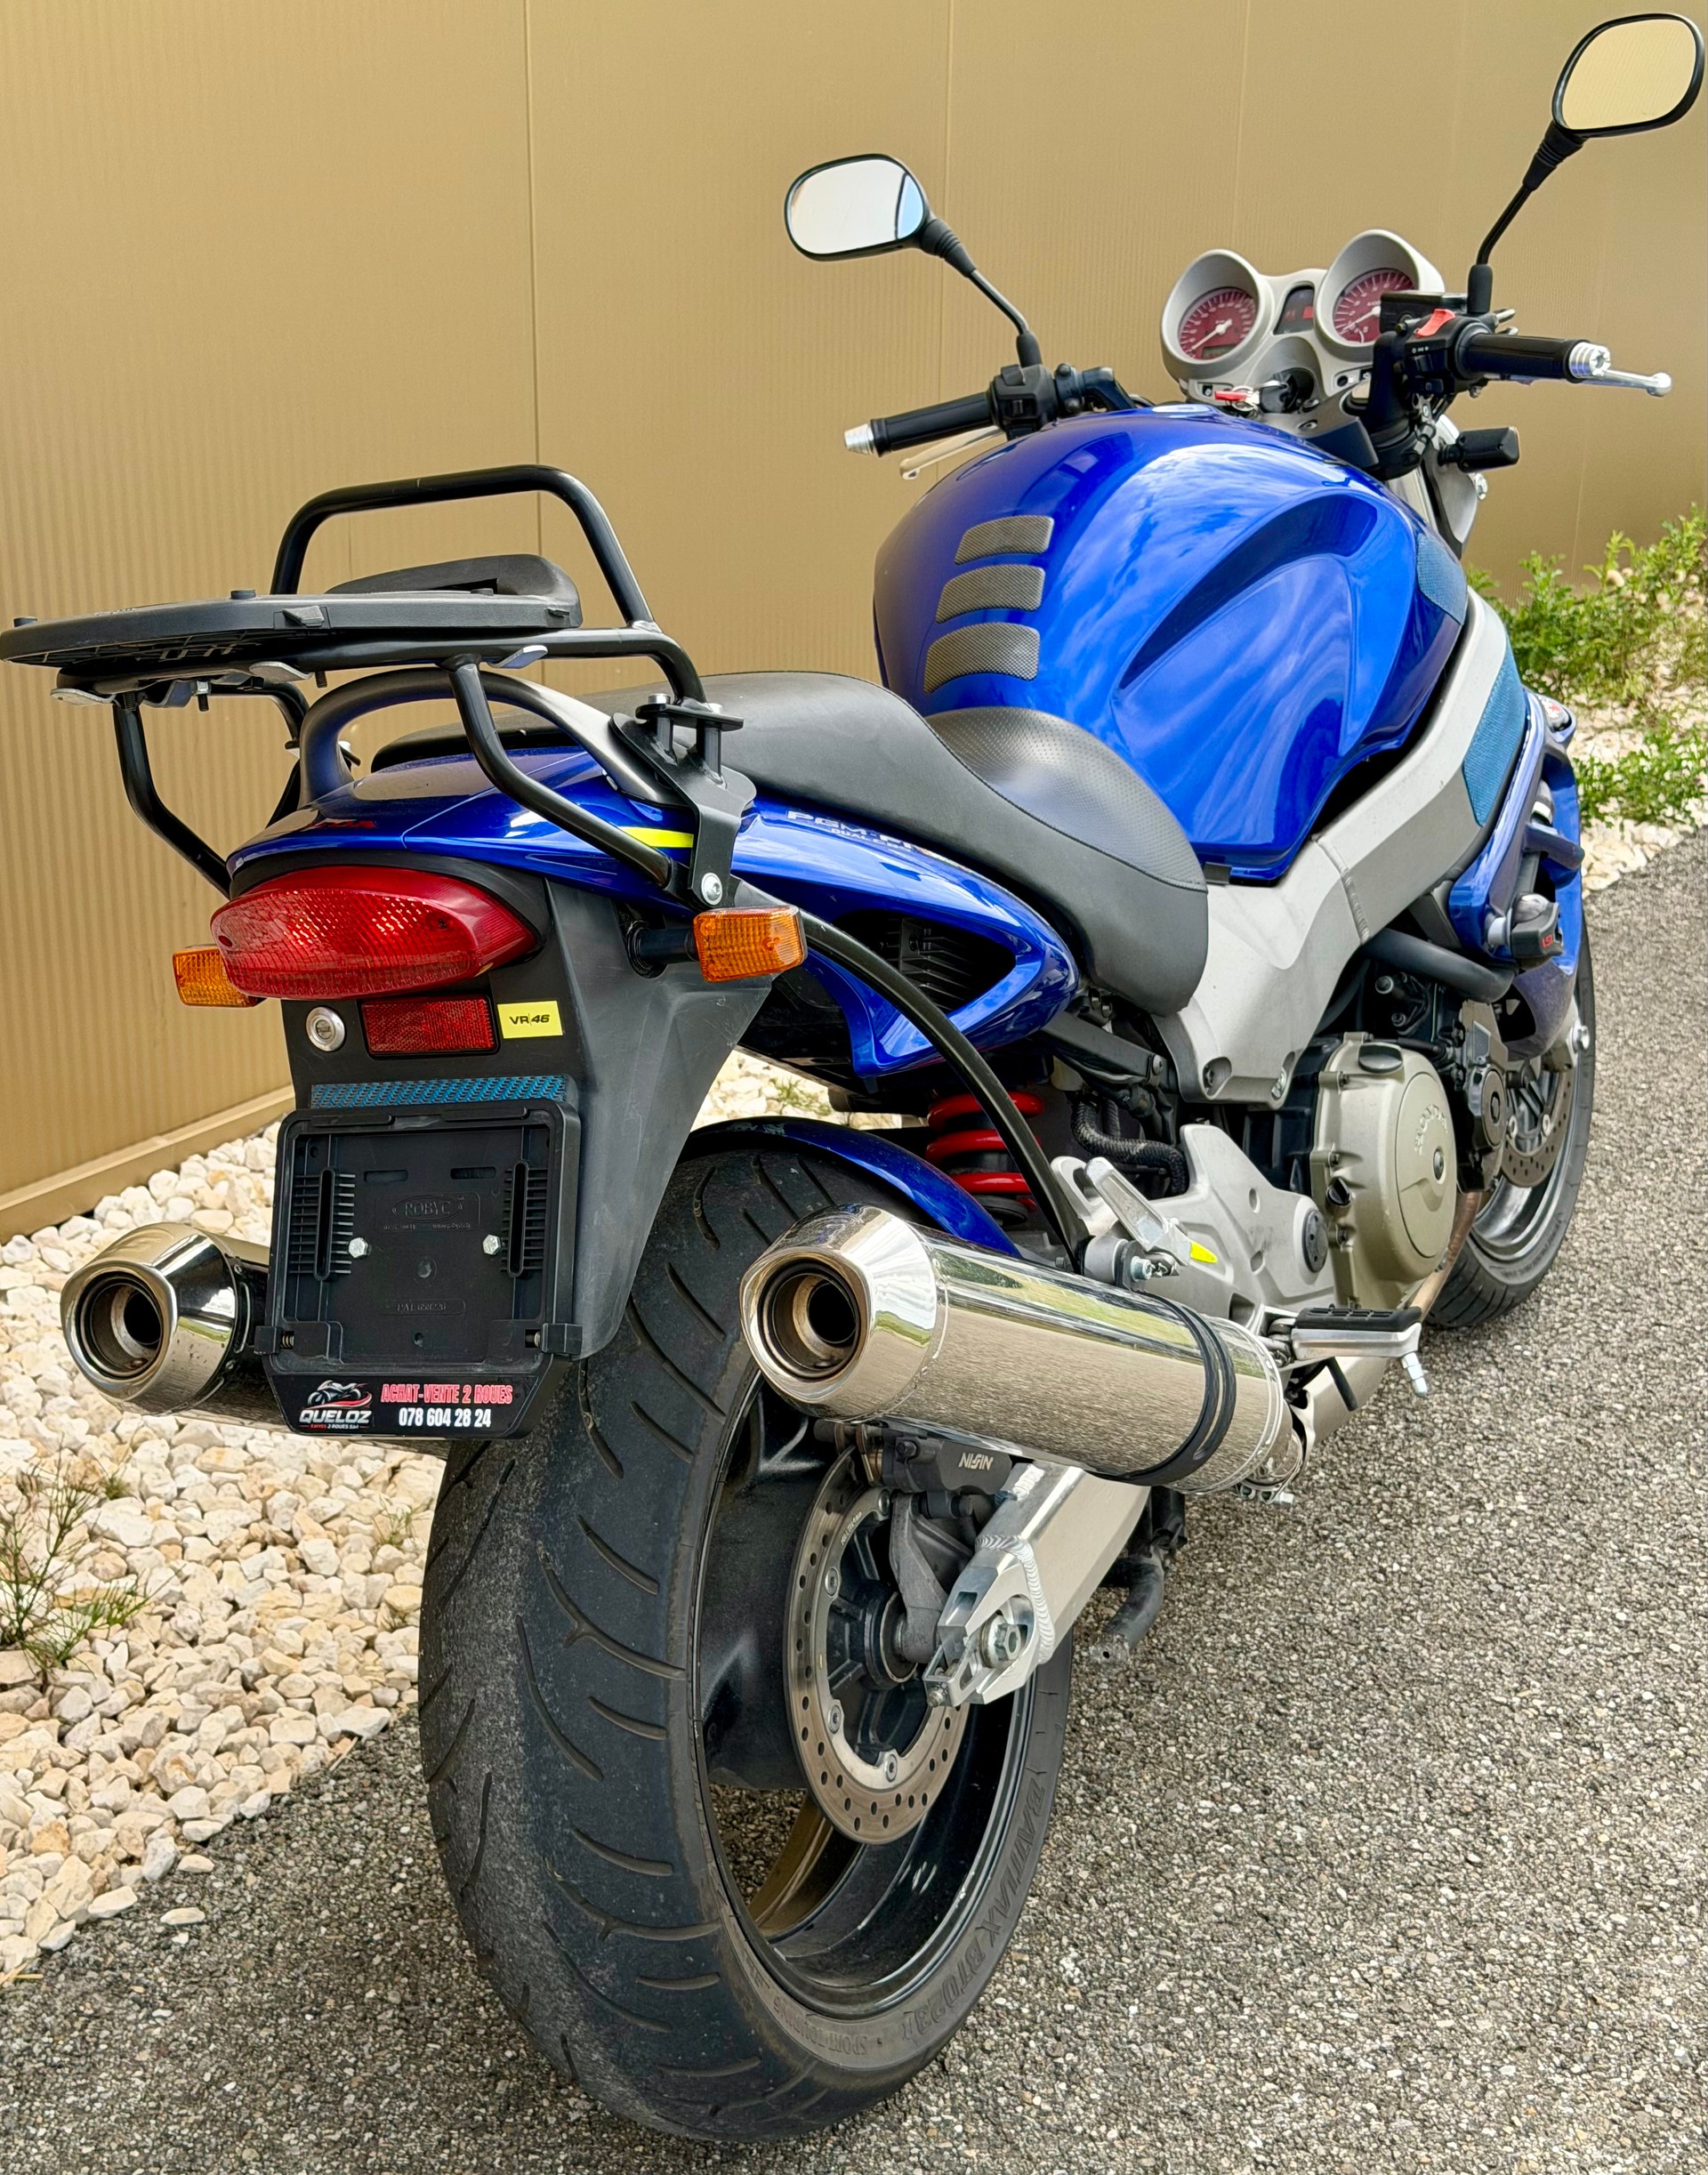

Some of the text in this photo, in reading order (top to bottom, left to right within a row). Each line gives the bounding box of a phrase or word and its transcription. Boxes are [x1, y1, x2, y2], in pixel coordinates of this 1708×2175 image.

[381, 1383, 513, 1405] ACHAT-VENTE 2 ROUES
[299, 1409, 372, 1424] QUELOZ
[399, 1407, 491, 1428] 078 604 28 24
